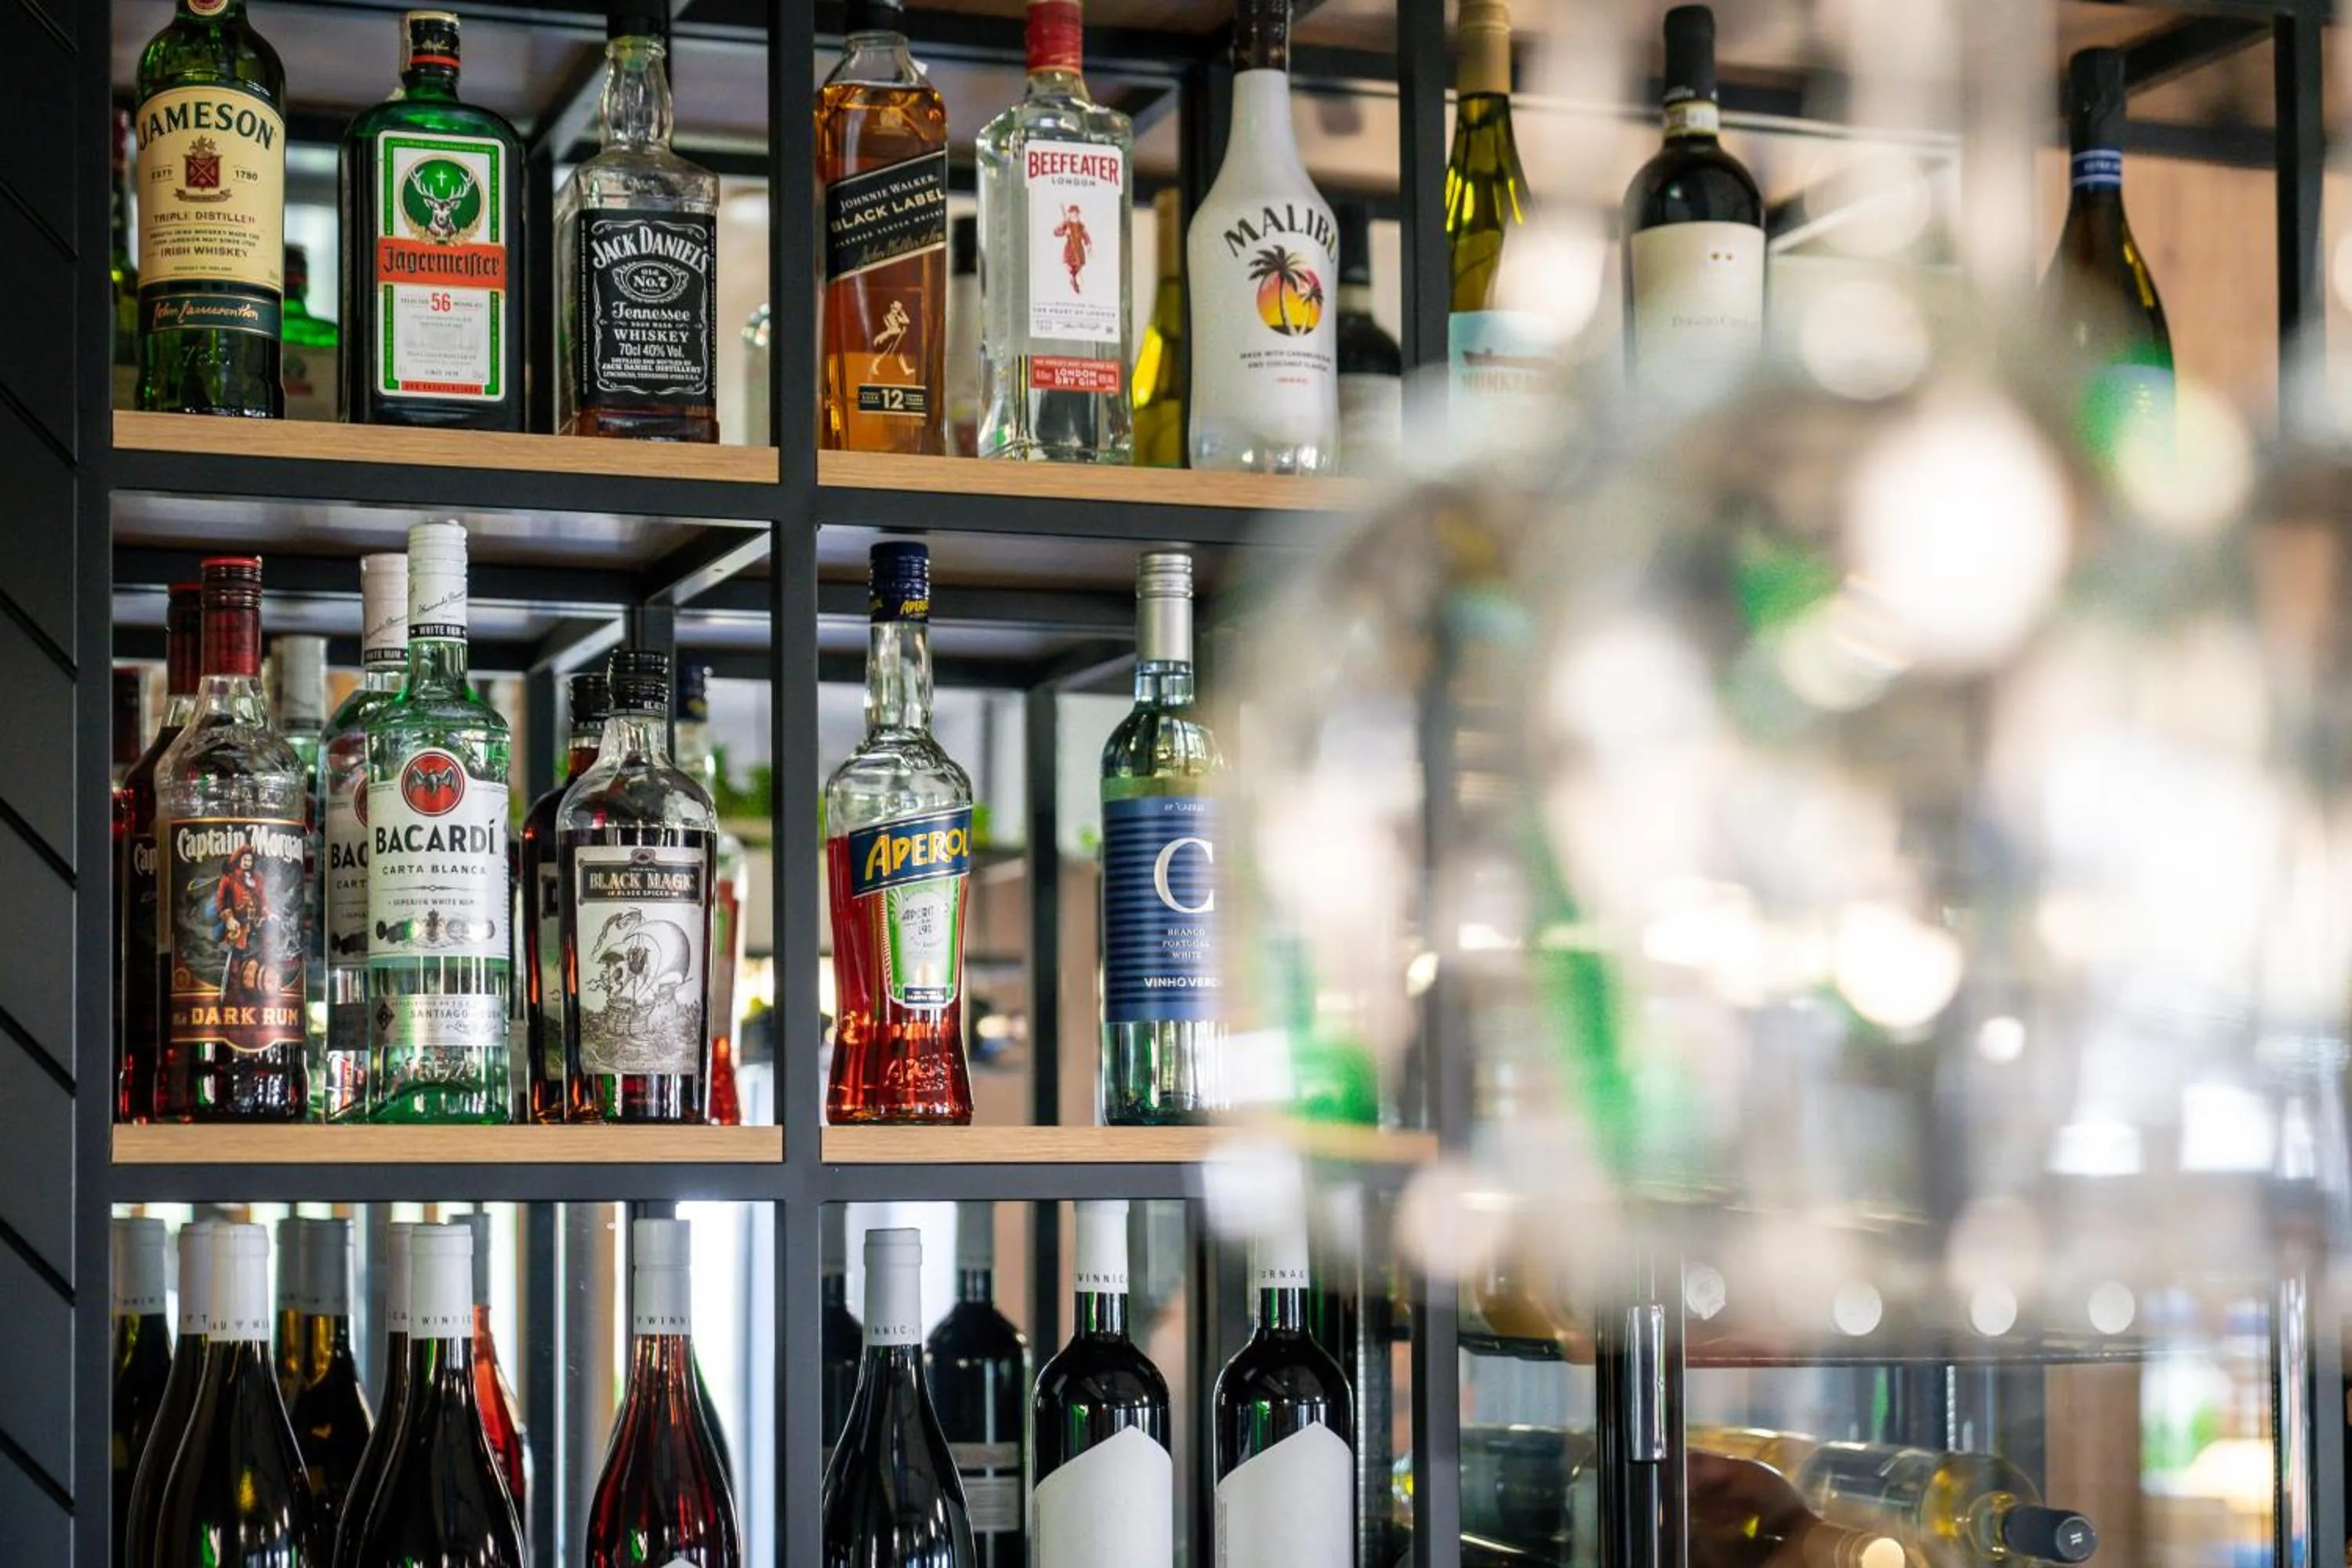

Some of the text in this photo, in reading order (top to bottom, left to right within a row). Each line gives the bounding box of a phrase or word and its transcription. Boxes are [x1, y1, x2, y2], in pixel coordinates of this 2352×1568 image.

[139, 101, 274, 151] JAMESON
[1028, 151, 1120, 187] BEEFEATER
[1051, 178, 1097, 187] LONDON
[840, 188, 888, 212] JOHNNIE
[830, 187, 946, 233] BLACK LABEL
[161, 245, 249, 258] IRISH WHISKEY
[590, 234, 640, 269] JACK
[431, 292, 451, 312] 56
[612, 300, 691, 321] Tennessee
[613, 328, 690, 343] WHISKEY
[619, 343, 641, 356] 70cl
[642, 343, 666, 357] 40%
[1054, 368, 1097, 377] LONDON
[1054, 376, 1076, 387] DRY
[1078, 377, 1098, 387] GIN
[881, 388, 904, 410] 12
[176, 825, 245, 862] Captain
[376, 818, 496, 855] BACARDÍ
[865, 827, 969, 881] APEROL
[382, 864, 487, 876] CARTA BLANCA
[1153, 837, 1214, 913] C
[590, 873, 642, 889] BLACK
[1172, 950, 1202, 959] WHITE
[1144, 977, 1186, 987] VINHO
[191, 1007, 257, 1025] DARK
[262, 1007, 299, 1026] RUM
[409, 1009, 469, 1018] SANTIAGO
